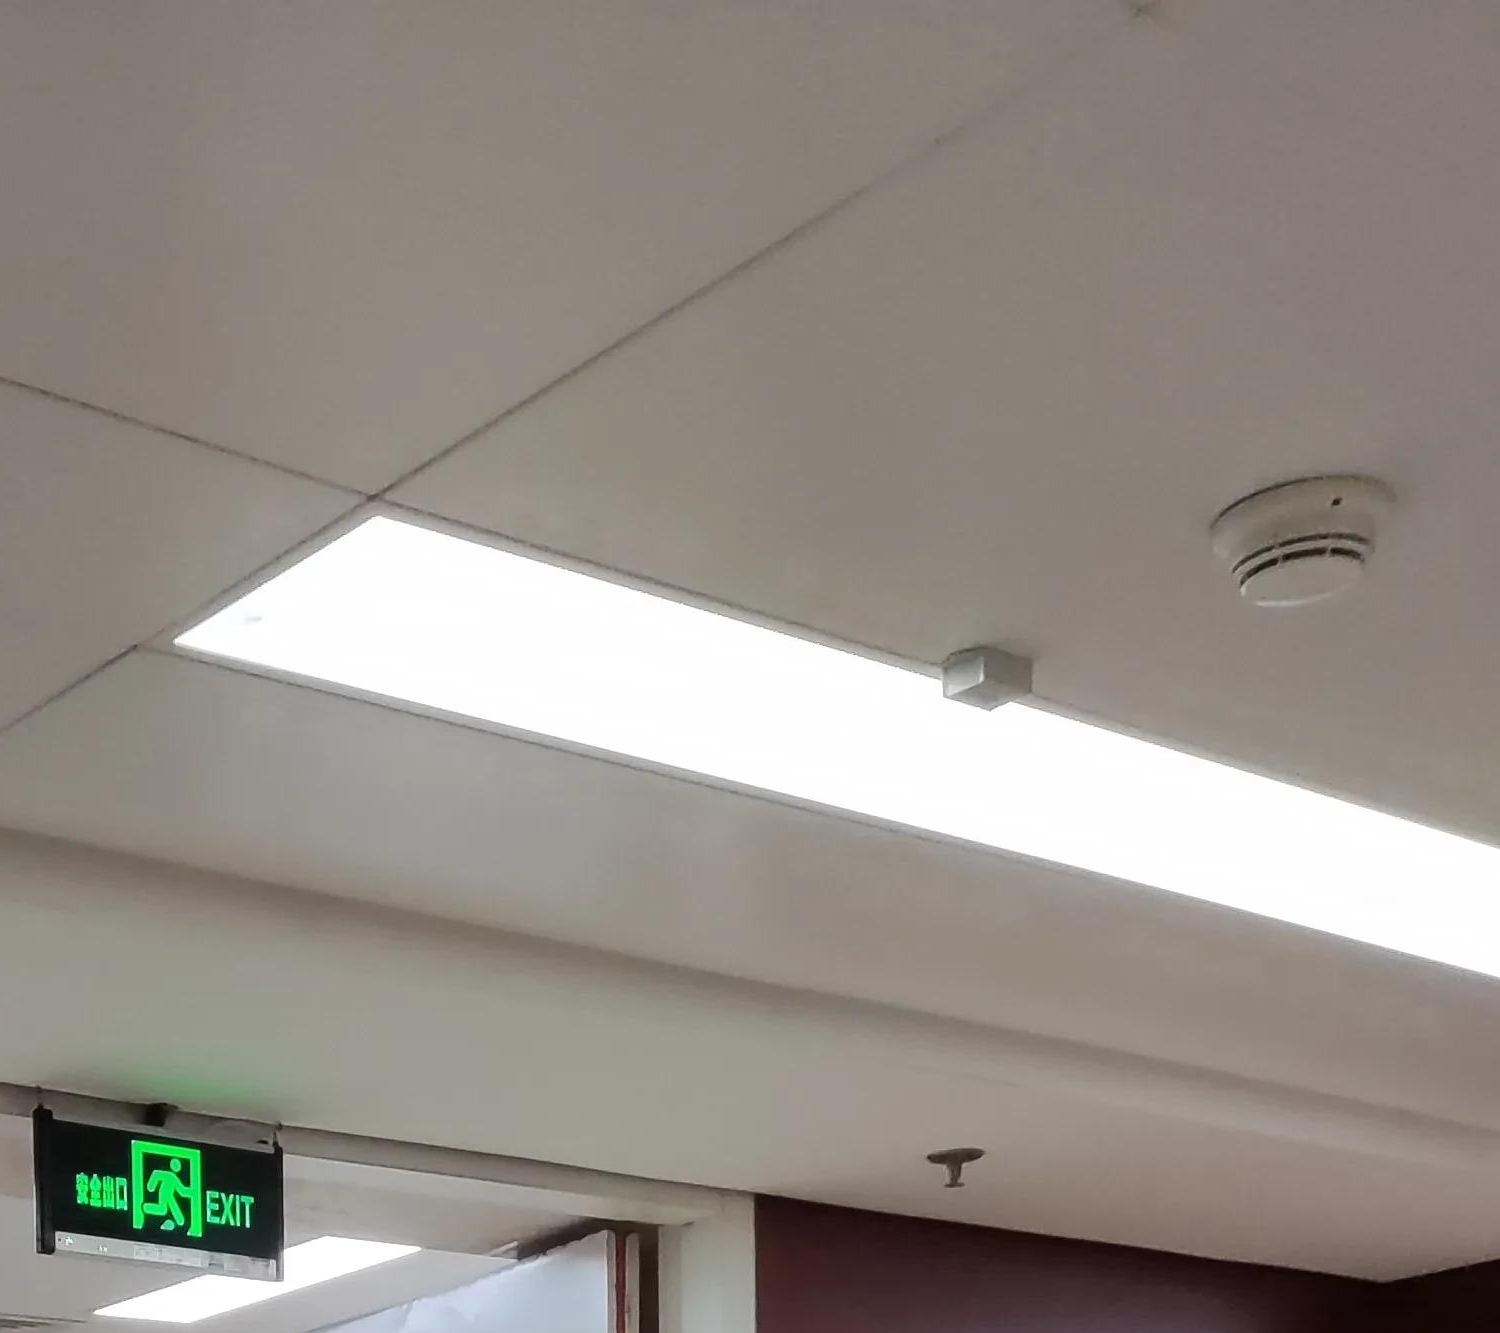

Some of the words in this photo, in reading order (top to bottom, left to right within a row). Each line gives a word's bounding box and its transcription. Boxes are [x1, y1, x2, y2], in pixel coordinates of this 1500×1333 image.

[76, 1172, 128, 1211] 安全出口
[206, 1190, 255, 1228] EXIT
